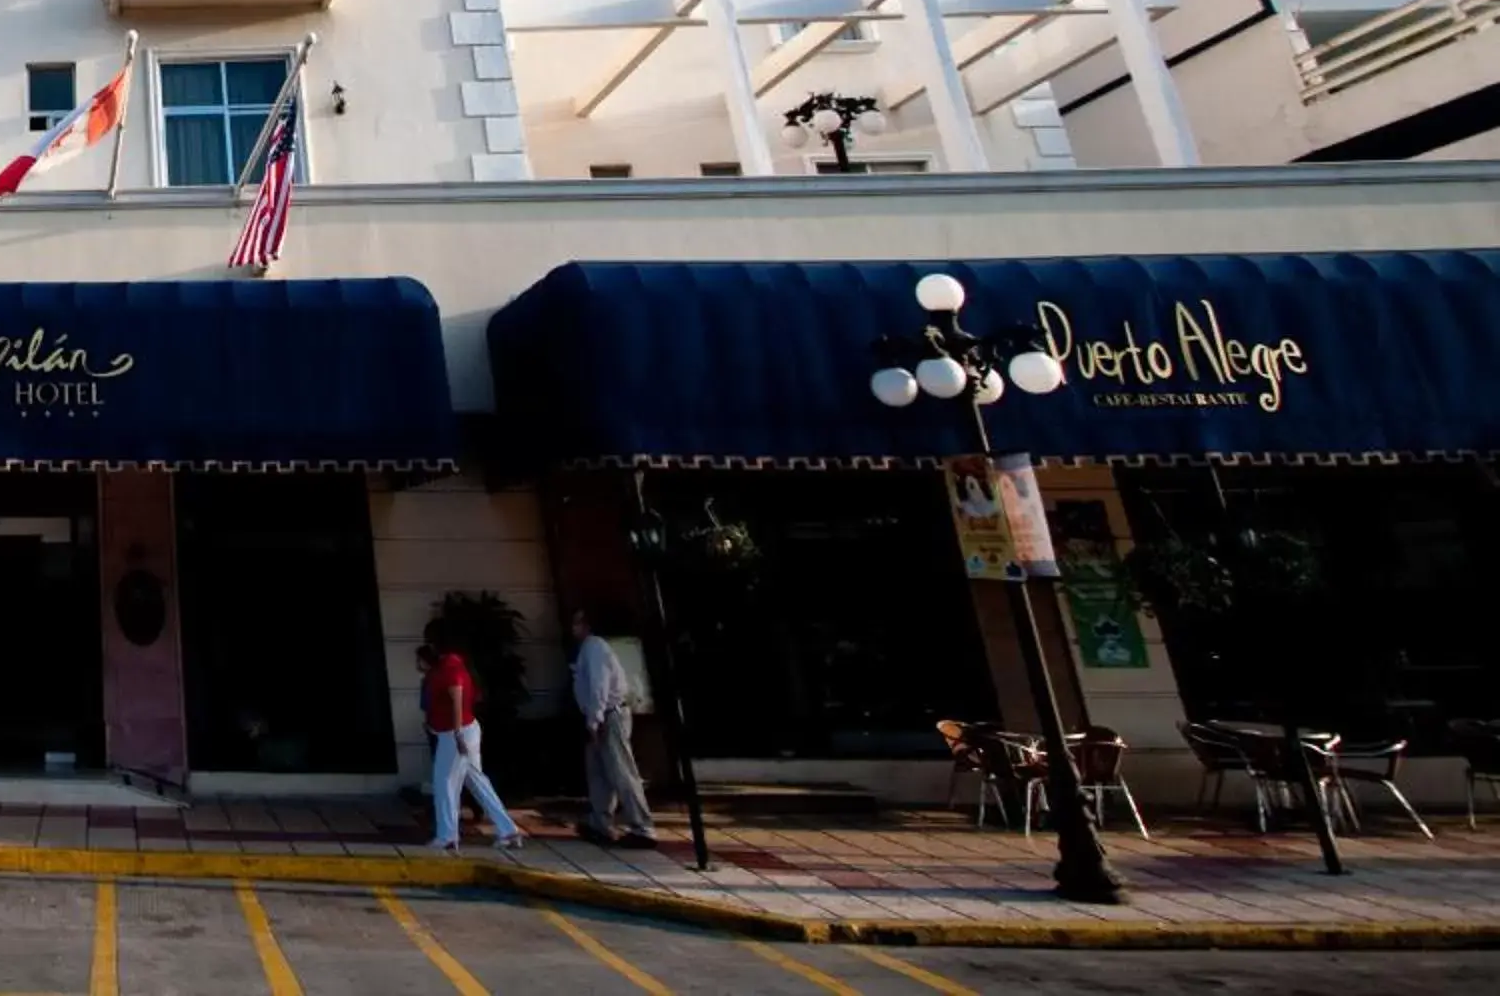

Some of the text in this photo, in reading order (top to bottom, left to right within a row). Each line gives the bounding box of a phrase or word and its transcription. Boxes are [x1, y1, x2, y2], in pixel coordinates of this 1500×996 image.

[1037, 299, 1307, 412] Puerto Alegre
[15, 381, 104, 405] HOTEL
